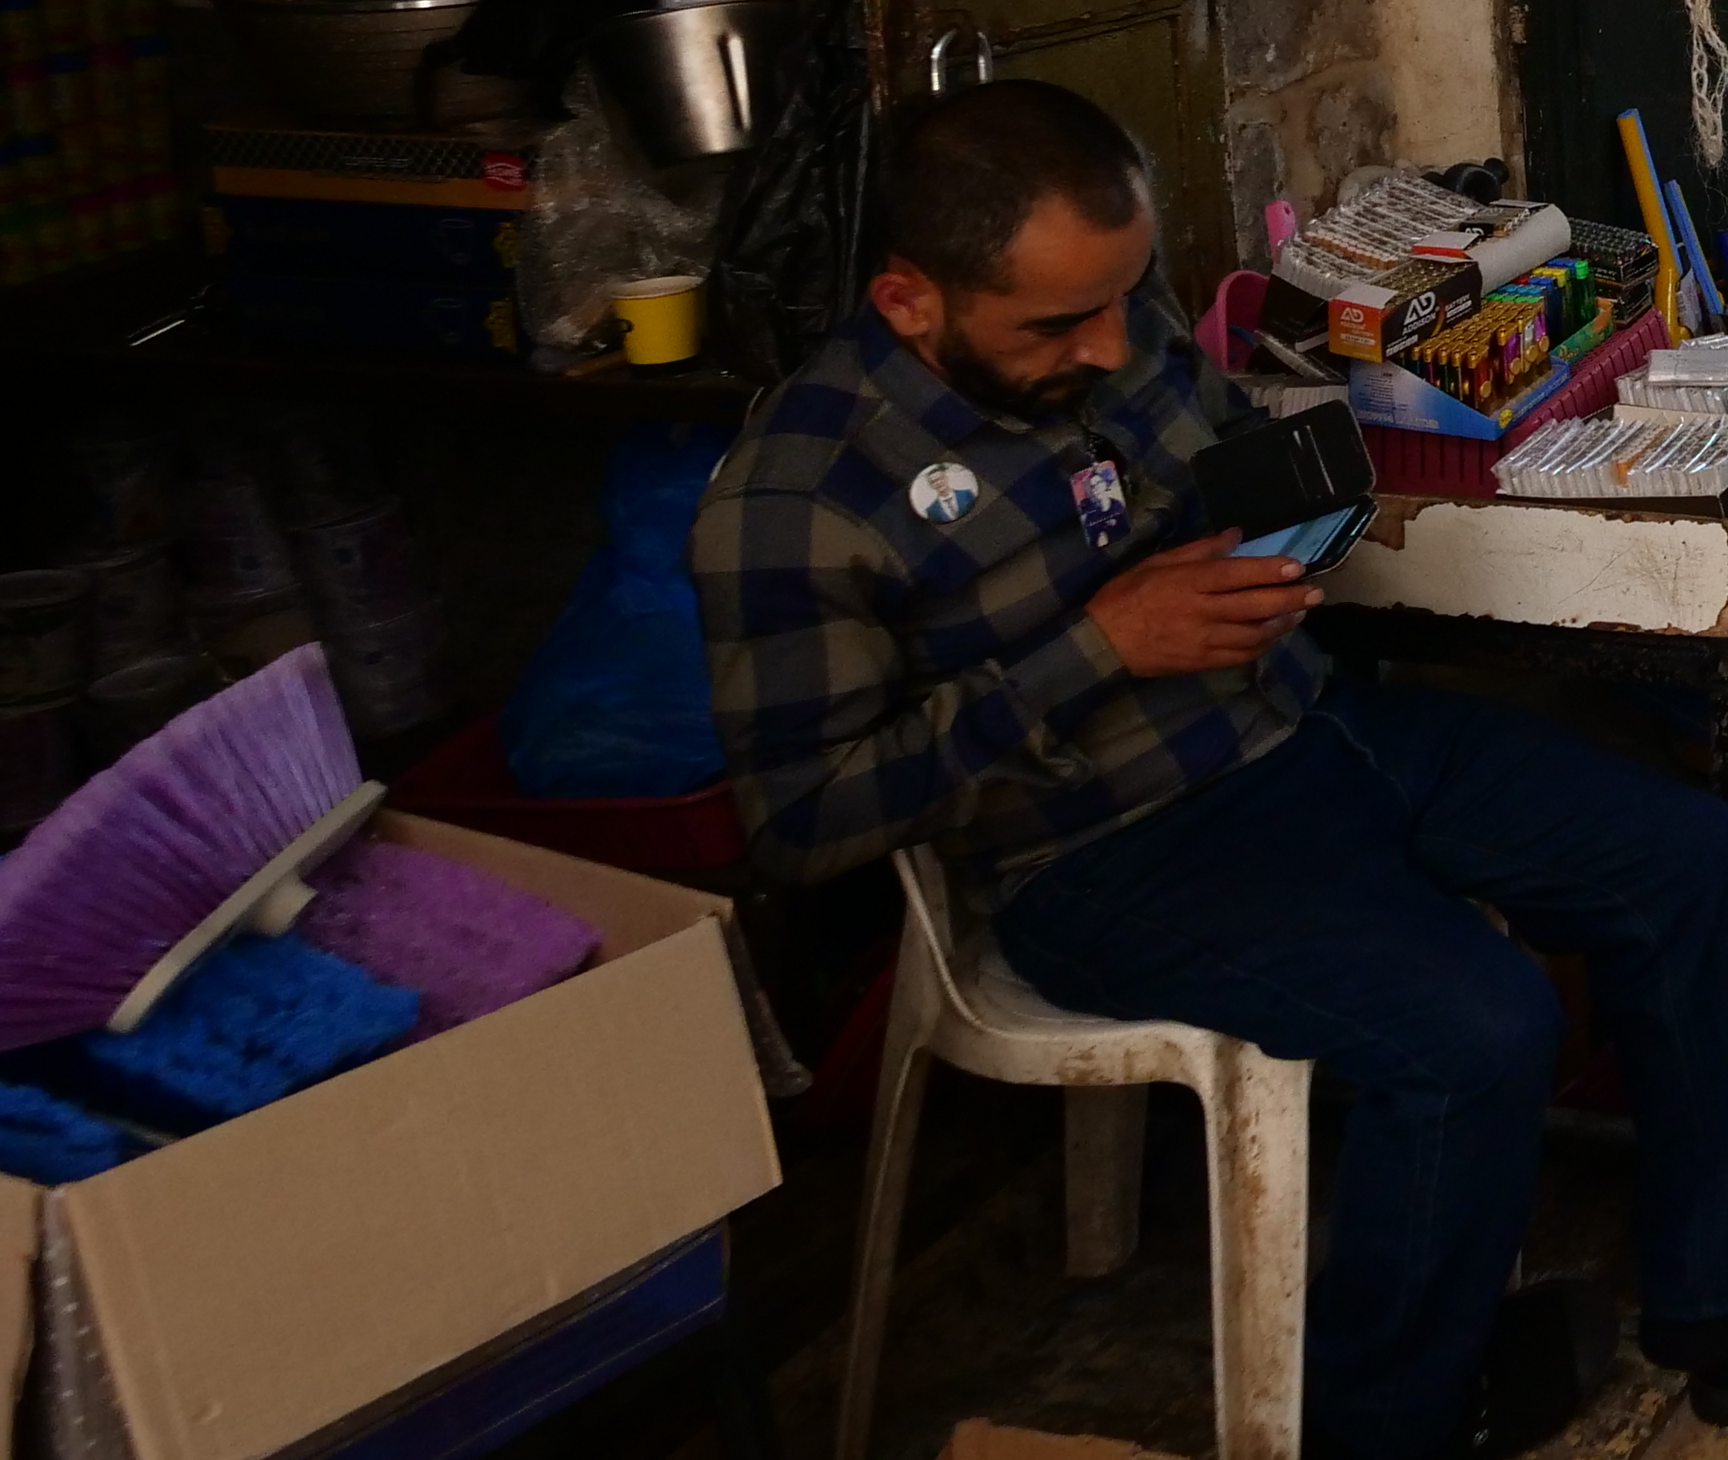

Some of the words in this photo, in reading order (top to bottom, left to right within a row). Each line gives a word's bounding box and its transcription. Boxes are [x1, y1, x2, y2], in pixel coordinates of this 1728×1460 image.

[1340, 307, 1364, 323] AD
[1403, 291, 1437, 326] AD
[1402, 312, 1437, 336] ADDISON
